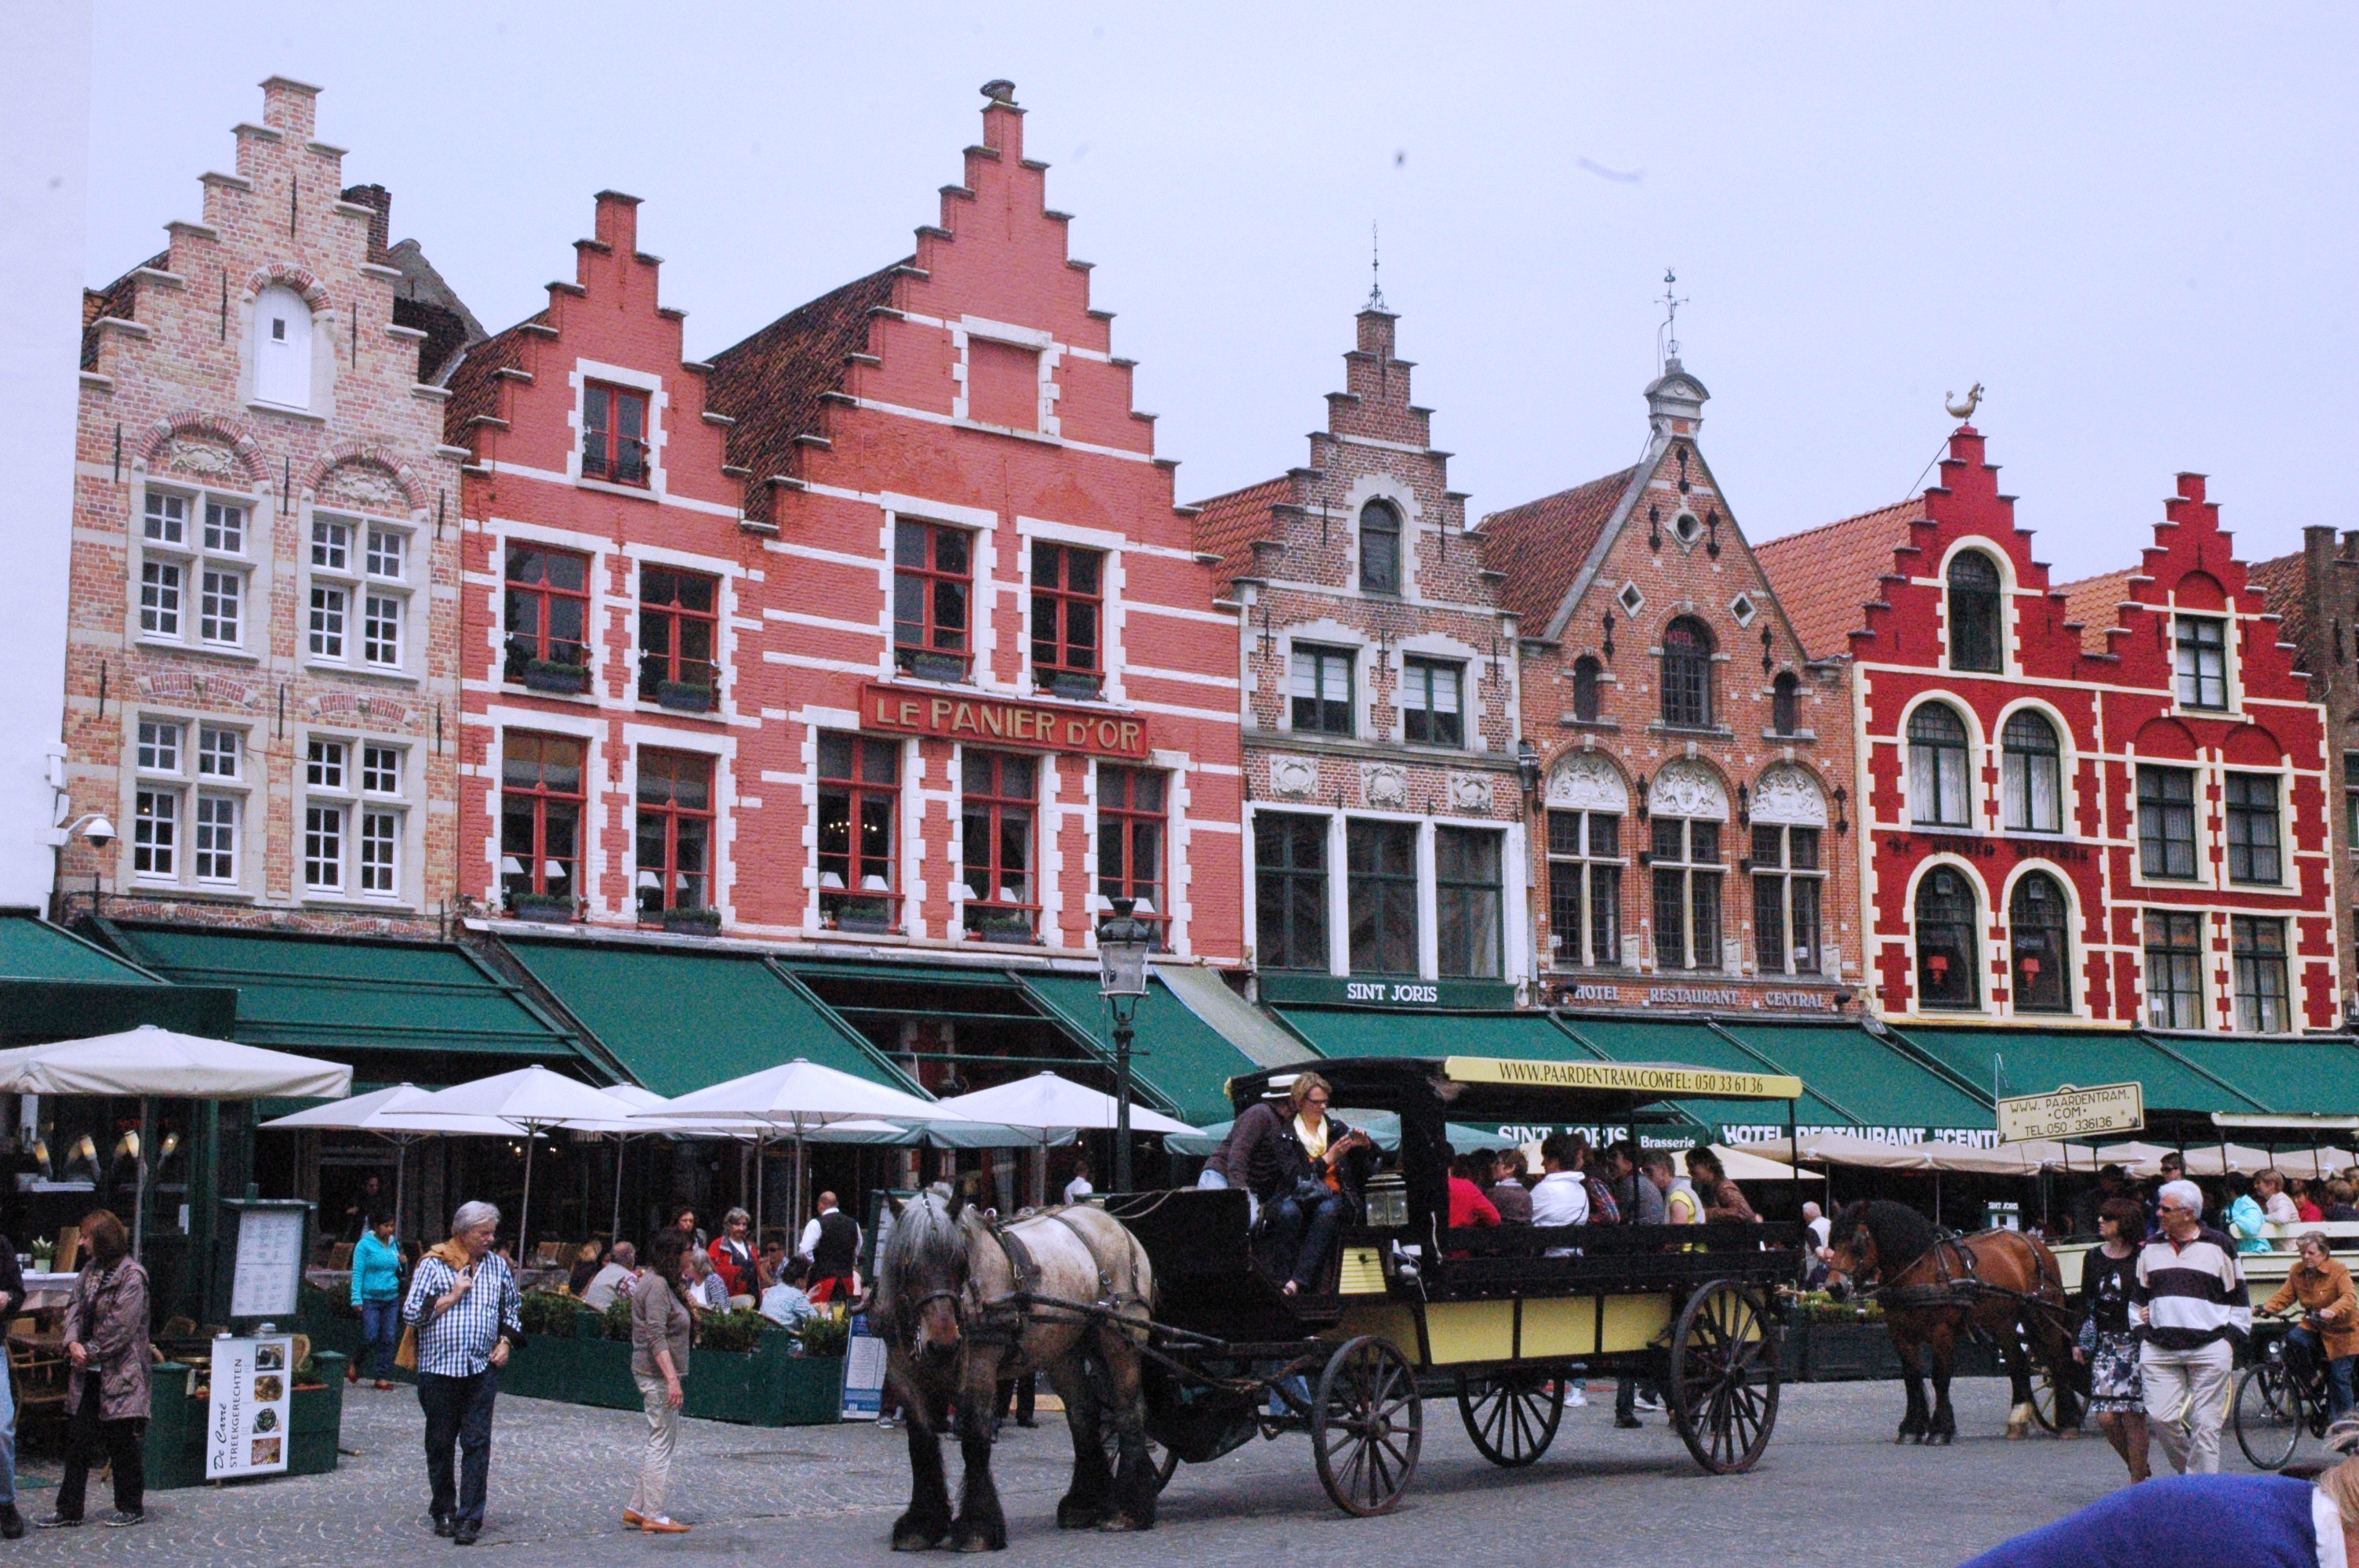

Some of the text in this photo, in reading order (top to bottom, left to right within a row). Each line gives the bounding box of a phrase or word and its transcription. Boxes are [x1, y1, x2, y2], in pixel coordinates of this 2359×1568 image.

[877, 699, 1140, 751] LE PANIER D'OR
[1347, 983, 1438, 1003] SINT JORIS
[1575, 985, 1824, 1007] HOTEL RESTAURANT CENTRAL
[1696, 1075, 1715, 1091] 050
[1719, 1076, 1732, 1091] 33
[1736, 1076, 1747, 1091] 61
[1750, 1077, 1763, 1093] 36
[2010, 1089, 2130, 1114] WWW. PAARDENTRAM.
[2075, 1116, 2112, 1131] 336136
[1641, 1136, 1696, 1148] Brasserie
[229, 1359, 243, 1468] STREEKGERECHTEN
[213, 1403, 227, 1470] De Carré
